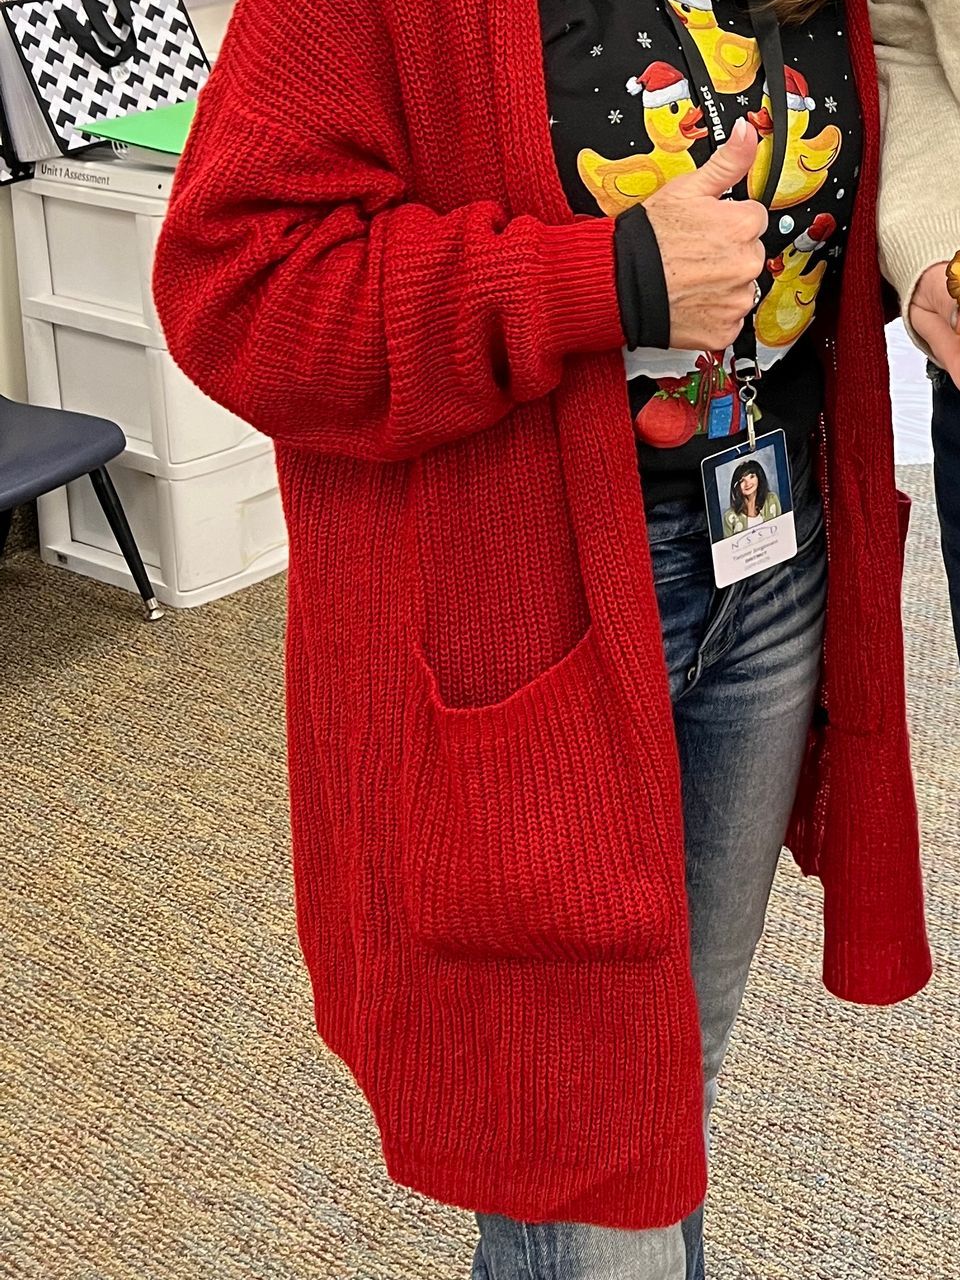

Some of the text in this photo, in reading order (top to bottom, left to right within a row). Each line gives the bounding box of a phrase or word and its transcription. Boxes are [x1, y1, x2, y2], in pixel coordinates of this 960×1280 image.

[700, 86, 726, 141] District
[41, 163, 57, 176] Unit
[64, 168, 110, 185] Assessment
